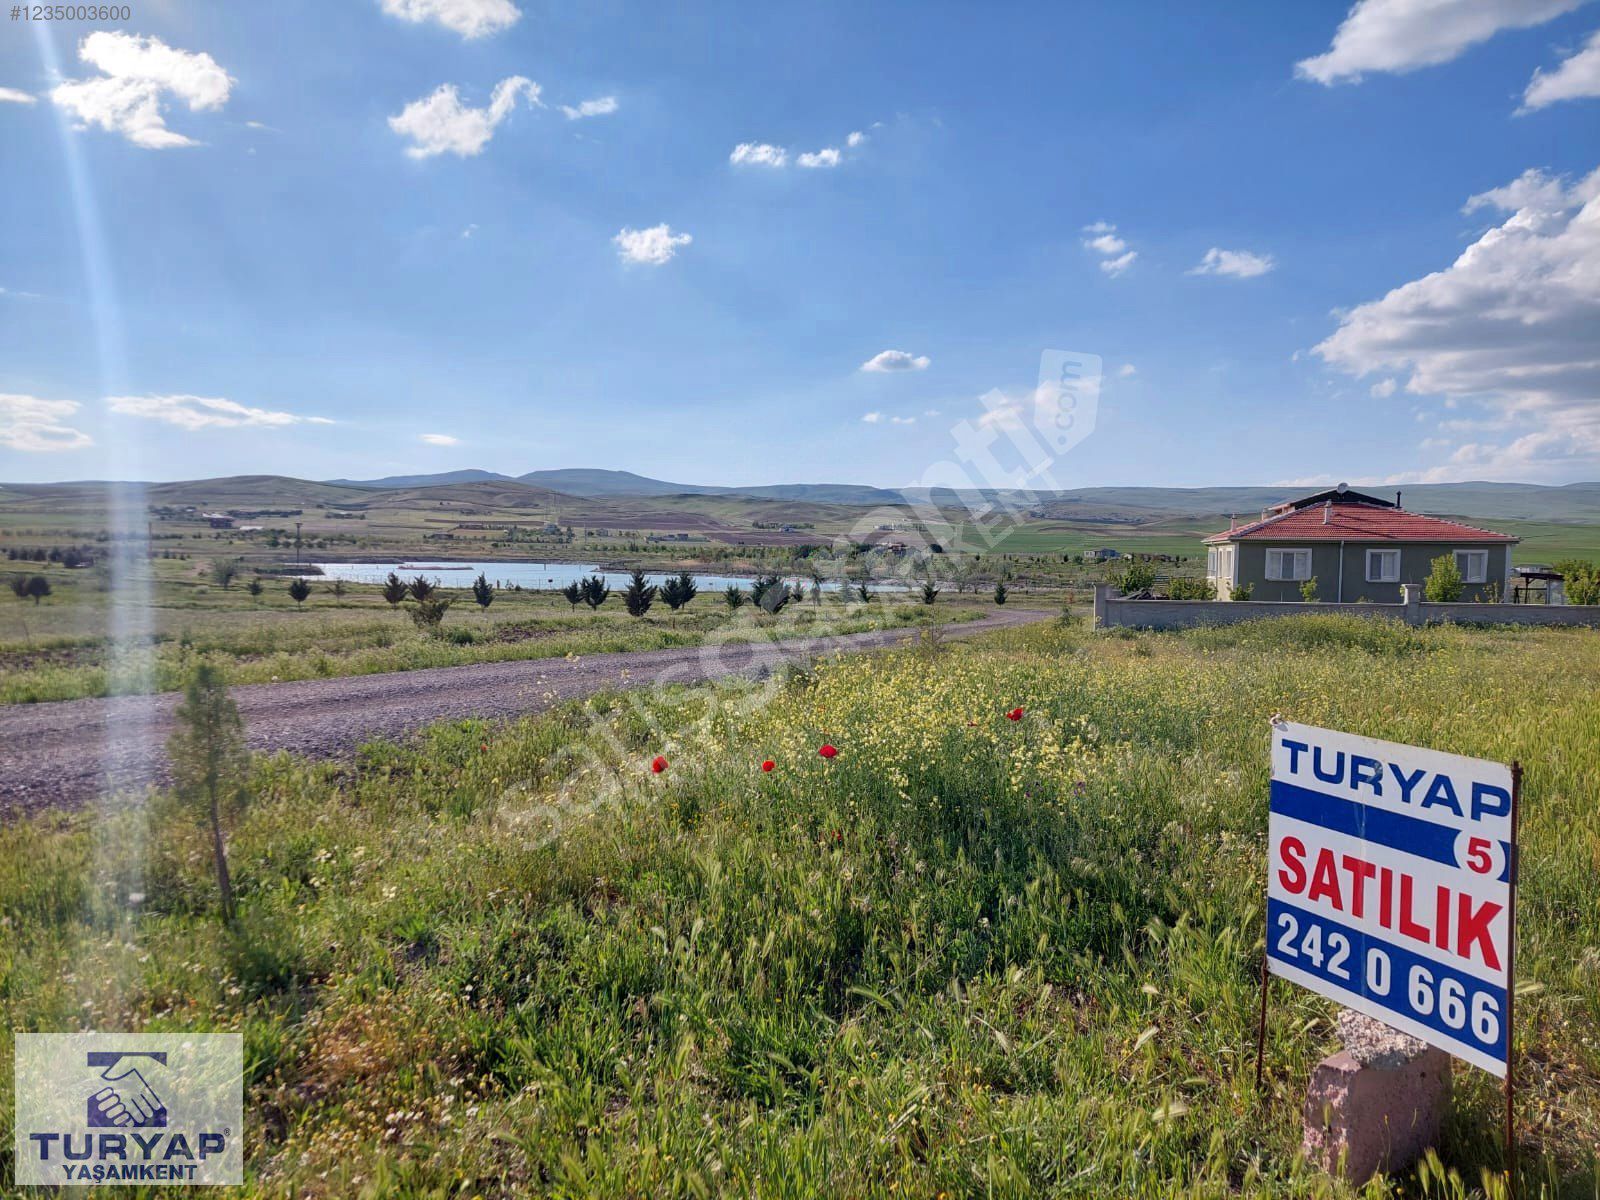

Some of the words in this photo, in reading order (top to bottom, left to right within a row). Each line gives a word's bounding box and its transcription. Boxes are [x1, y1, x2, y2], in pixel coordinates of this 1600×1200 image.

[1281, 739, 1511, 821] TURYAP
[1278, 836, 1503, 972] SATILIK
[1466, 836, 1492, 874] 5
[1277, 912, 1351, 981] 242
[1366, 948, 1391, 997] 0
[1408, 964, 1500, 1045] 666
